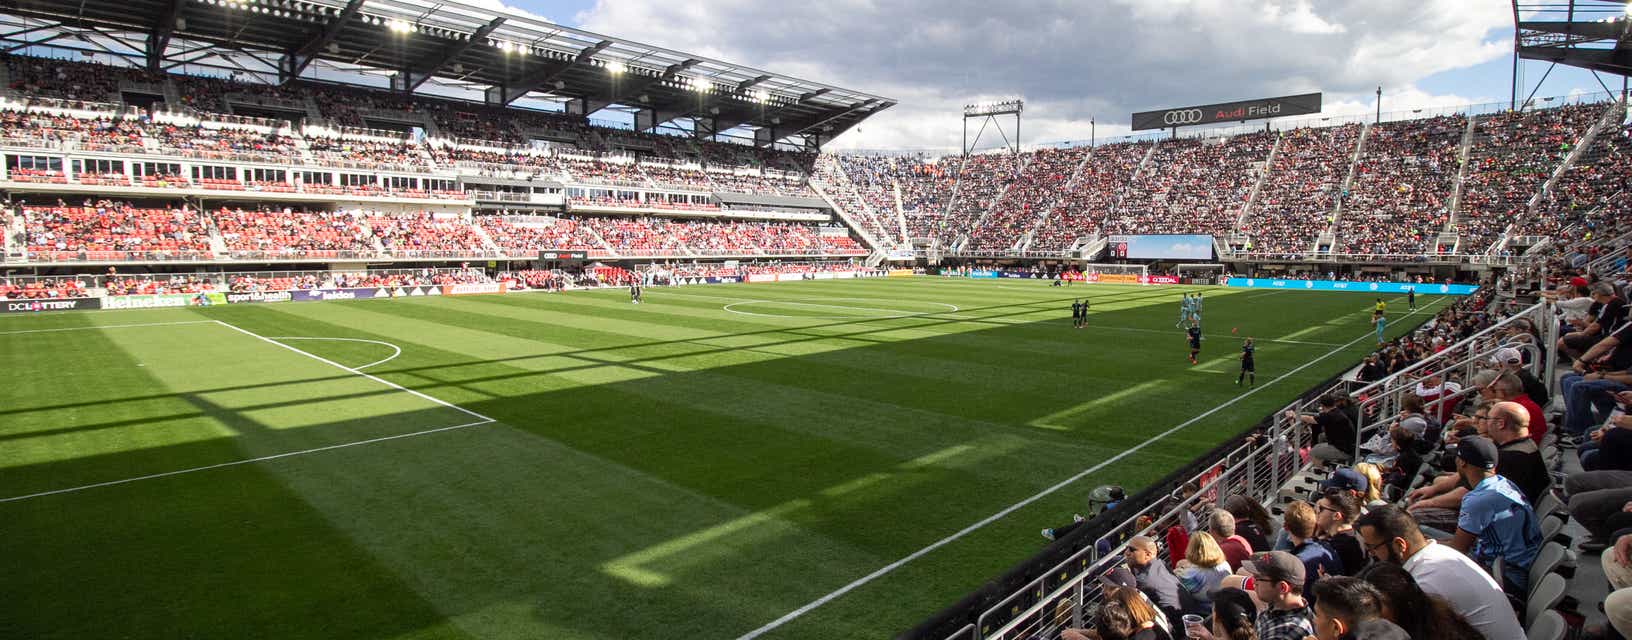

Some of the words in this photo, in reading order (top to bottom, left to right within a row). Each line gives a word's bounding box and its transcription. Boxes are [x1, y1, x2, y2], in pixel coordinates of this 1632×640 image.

[1215, 107, 1245, 119] Audi
[1248, 103, 1281, 116] Field
[101, 293, 184, 309] Heineken
[322, 290, 356, 300] leidos
